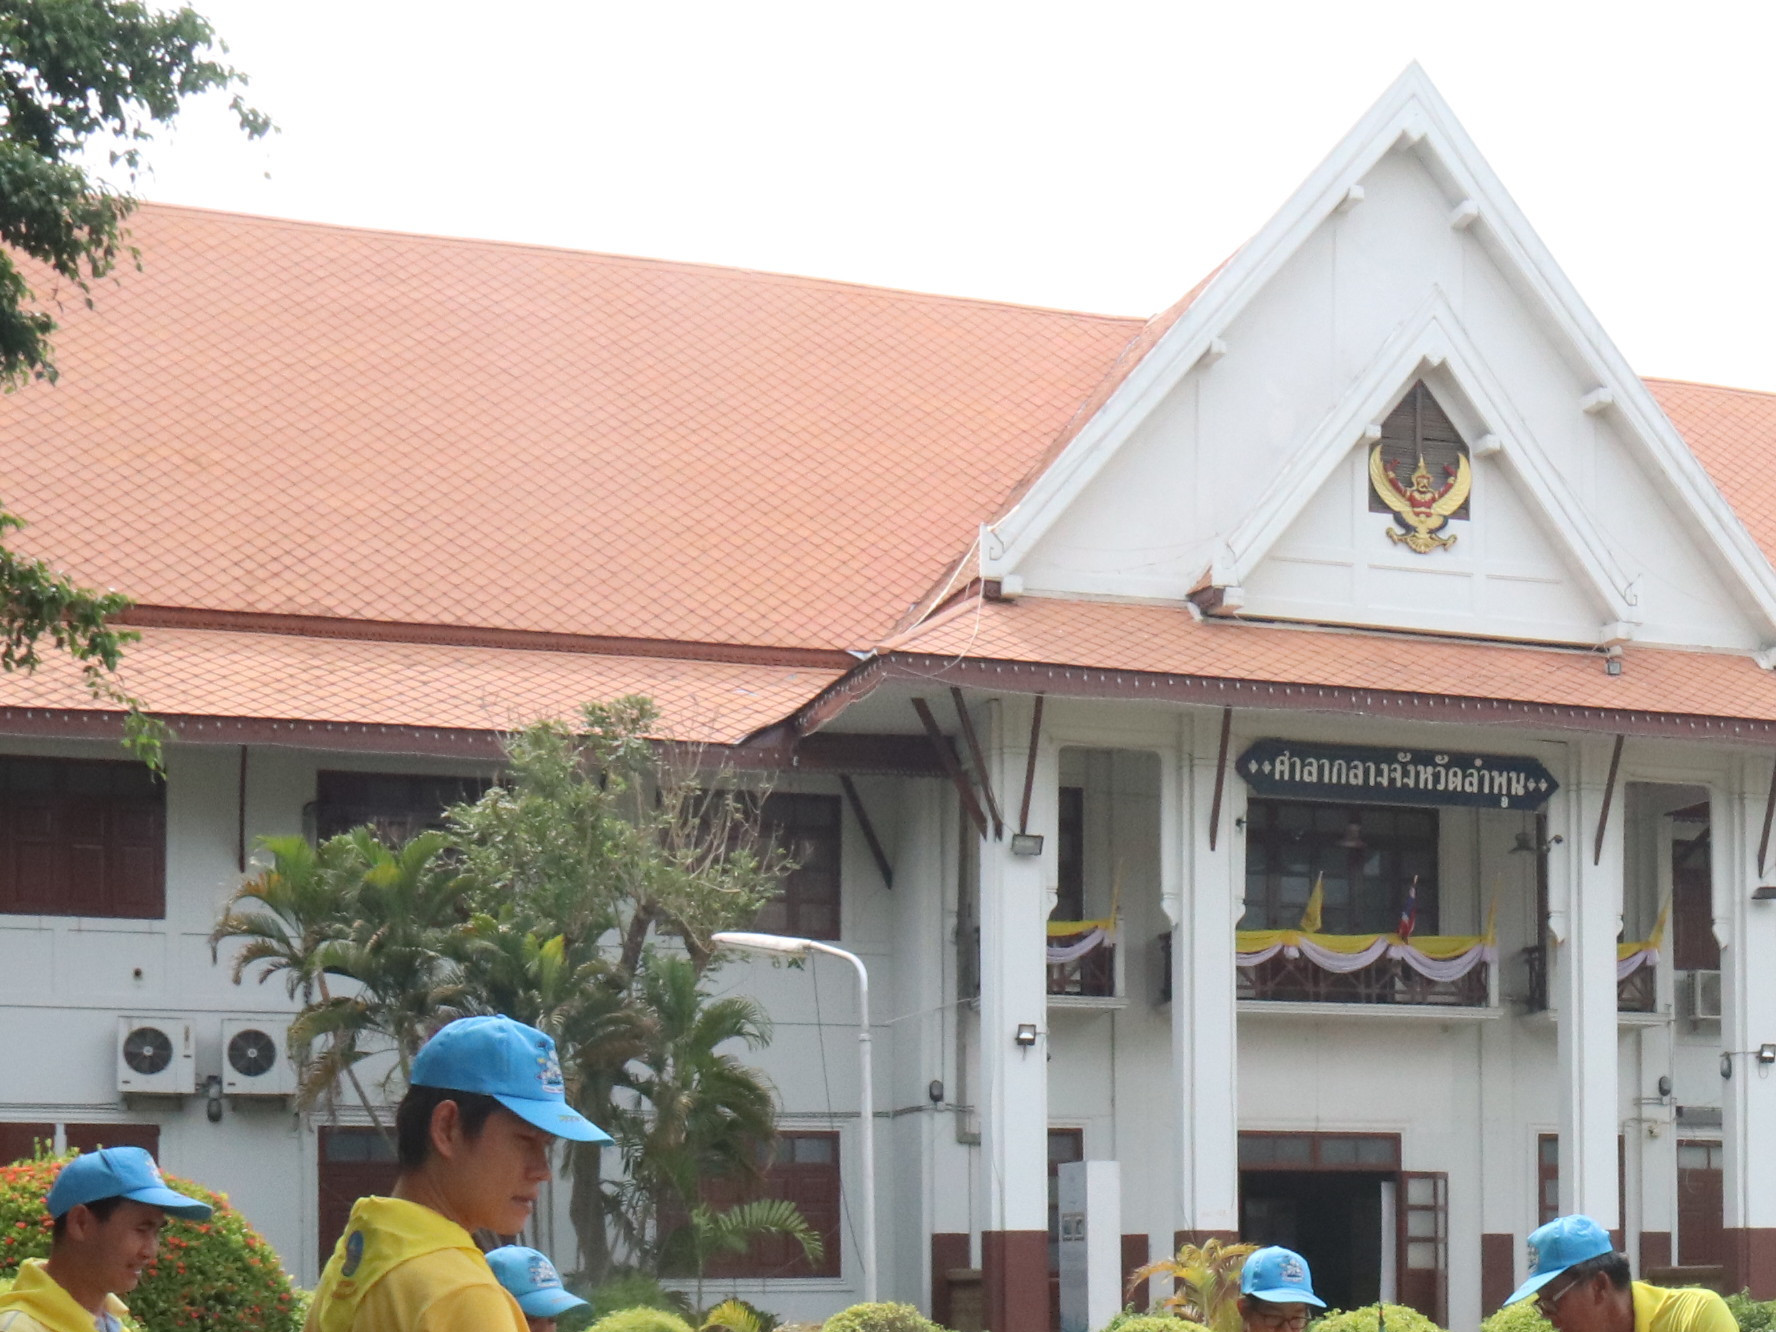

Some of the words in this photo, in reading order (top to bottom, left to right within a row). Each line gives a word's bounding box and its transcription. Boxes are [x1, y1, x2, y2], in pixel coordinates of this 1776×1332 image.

[1273, 751, 1526, 808] ศาลากลางจังหวัดลำพูน
